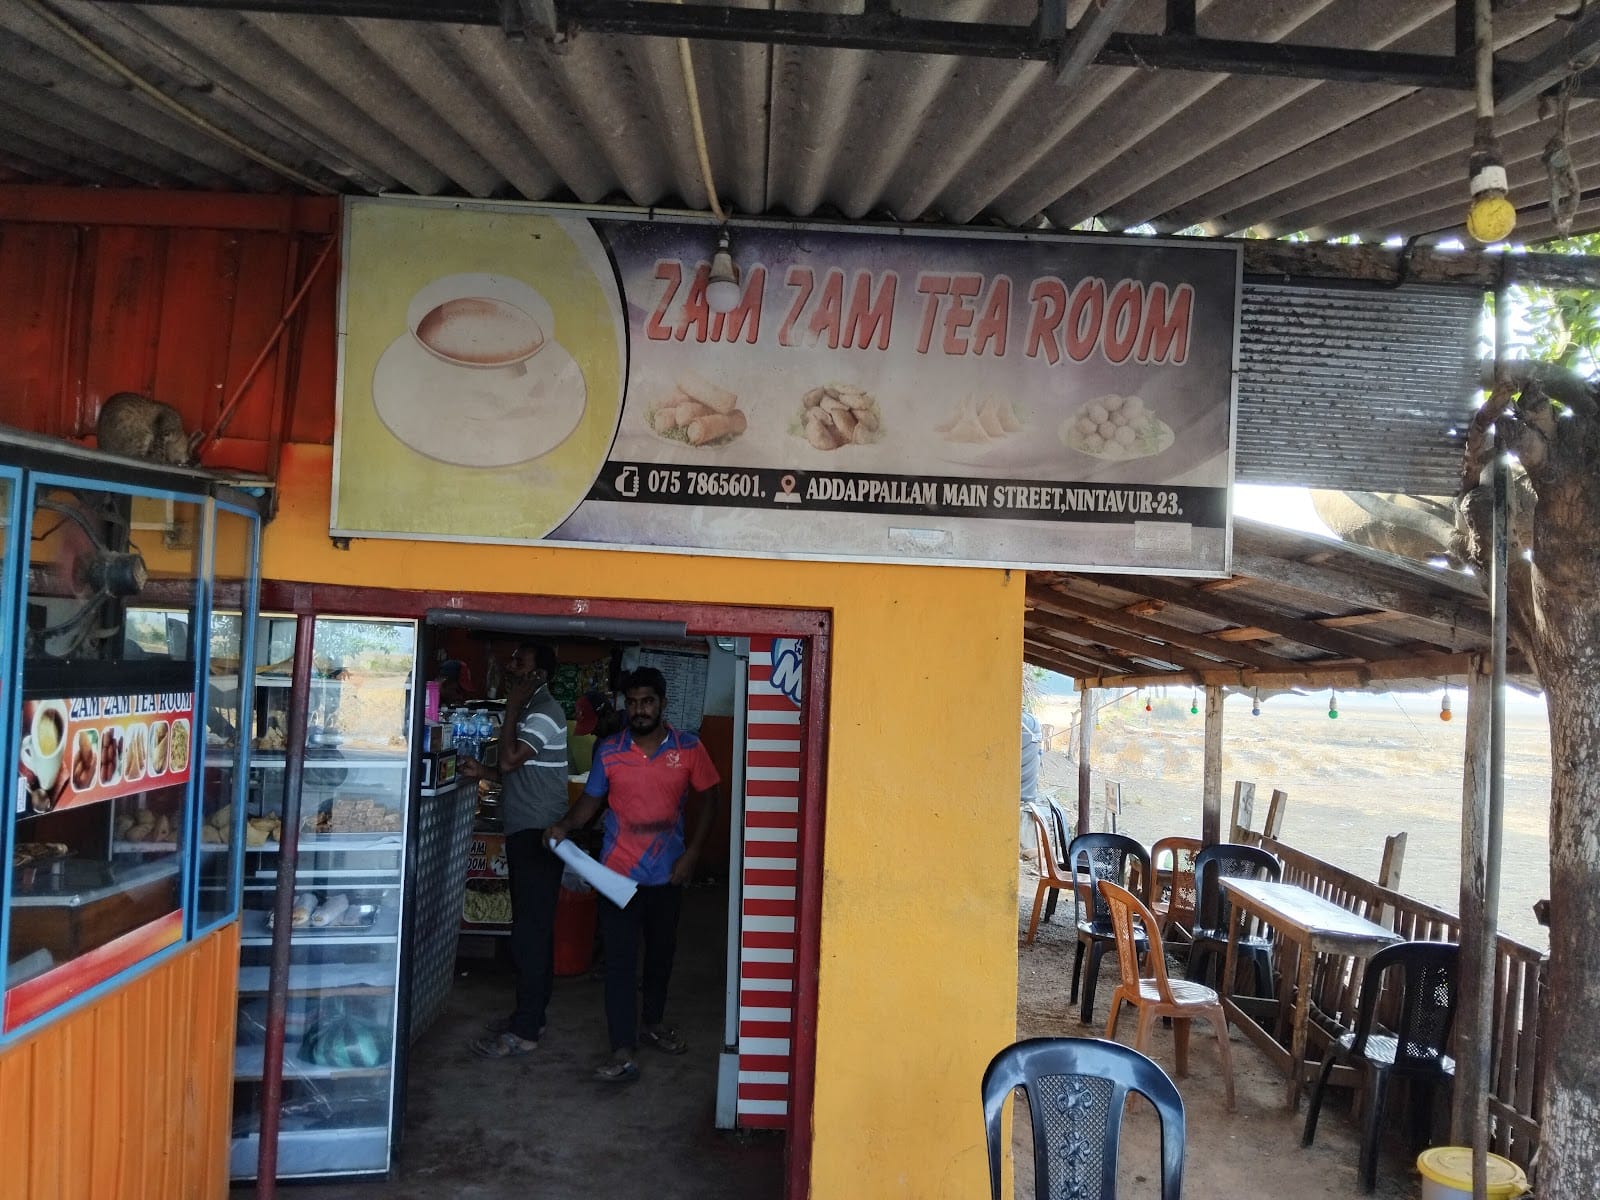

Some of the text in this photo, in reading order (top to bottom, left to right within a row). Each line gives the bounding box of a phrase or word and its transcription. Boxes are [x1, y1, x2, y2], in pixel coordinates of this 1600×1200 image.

[647, 260, 1193, 364] ZAM ZAM TEA ROOM
[647, 469, 766, 499] 075 7865601.
[806, 477, 938, 505] ADDAPPALLAM
[943, 483, 988, 508] MAIN
[71, 697, 100, 719] ZAM
[103, 695, 130, 715] ZAM
[134, 693, 157, 713] TEA
